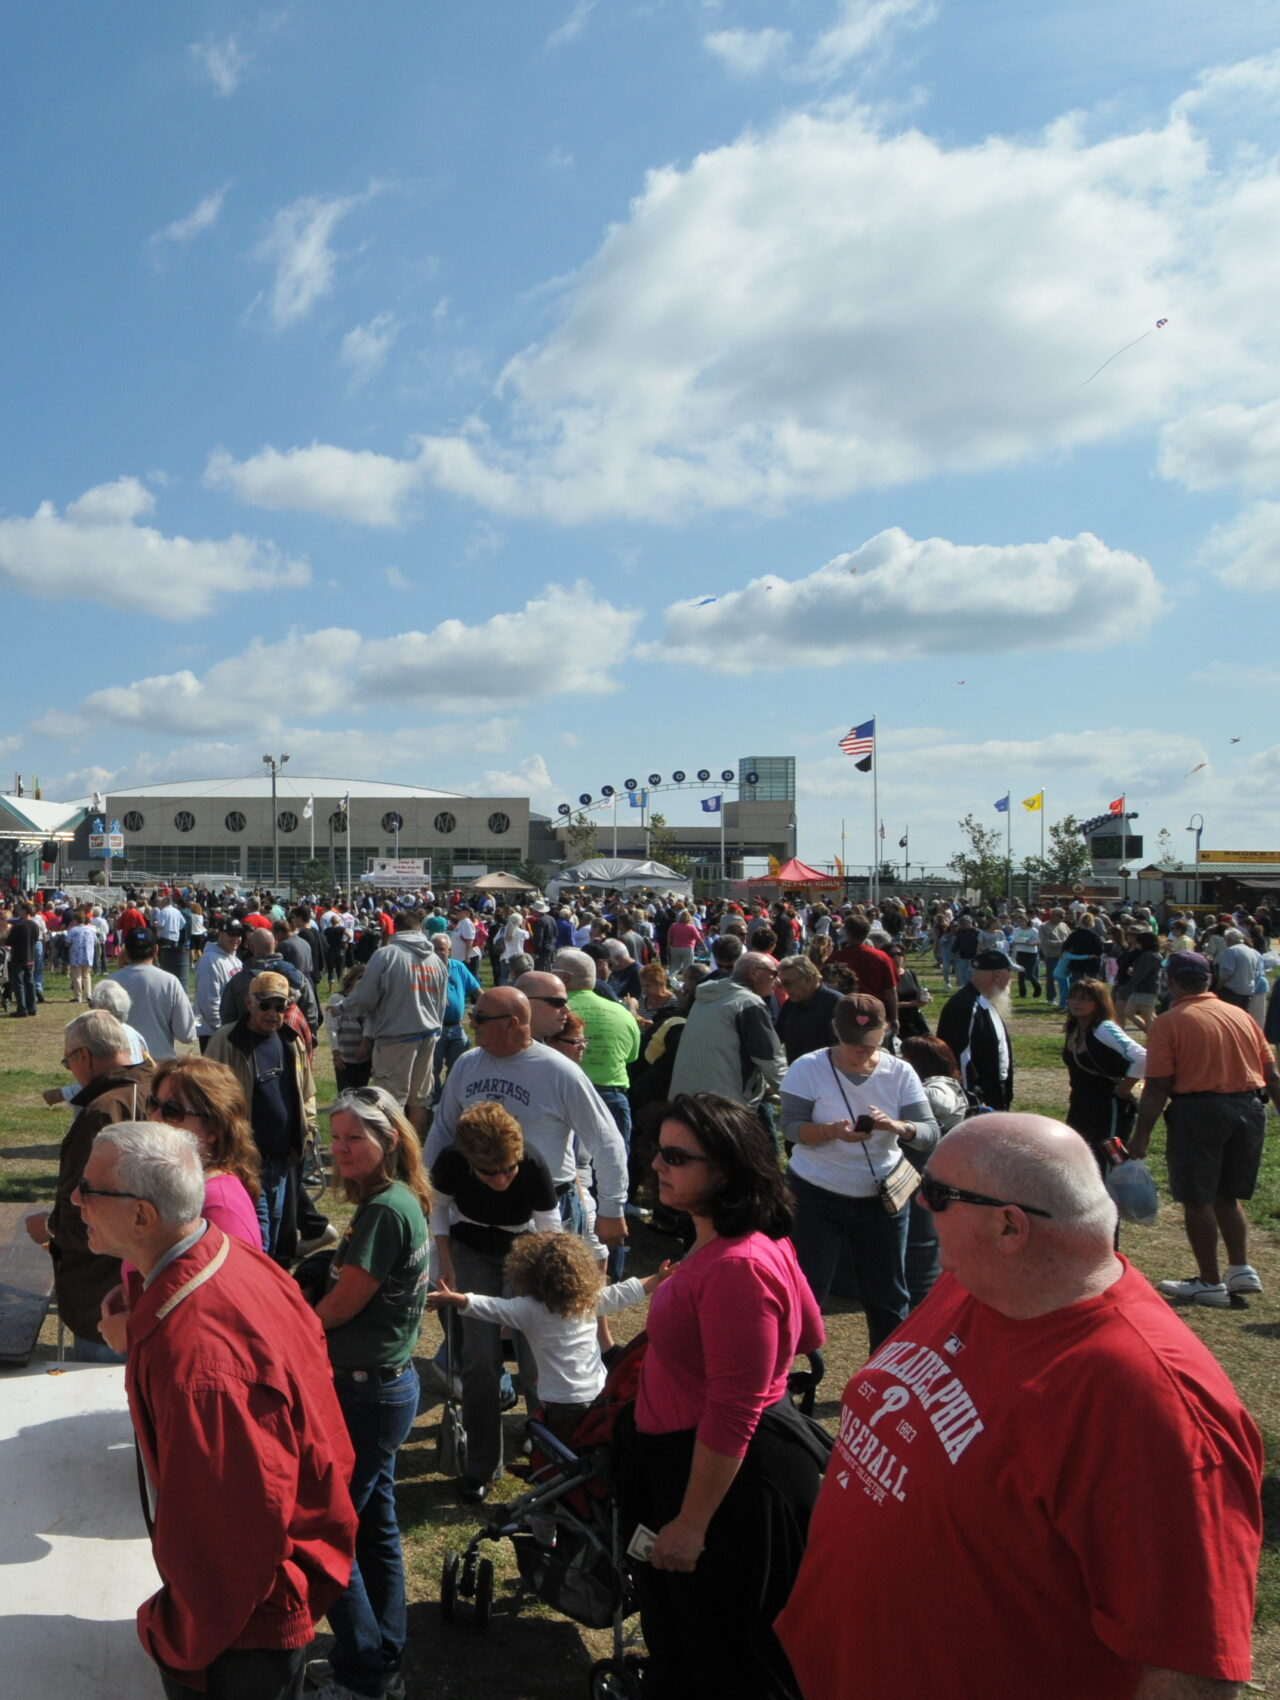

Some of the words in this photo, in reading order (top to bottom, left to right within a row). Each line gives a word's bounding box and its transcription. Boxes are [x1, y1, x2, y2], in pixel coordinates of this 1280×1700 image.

[465, 1078, 531, 1107] SMARTASS
[895, 1418, 918, 1444] 1883
[840, 1404, 909, 1503] ASEBALL
